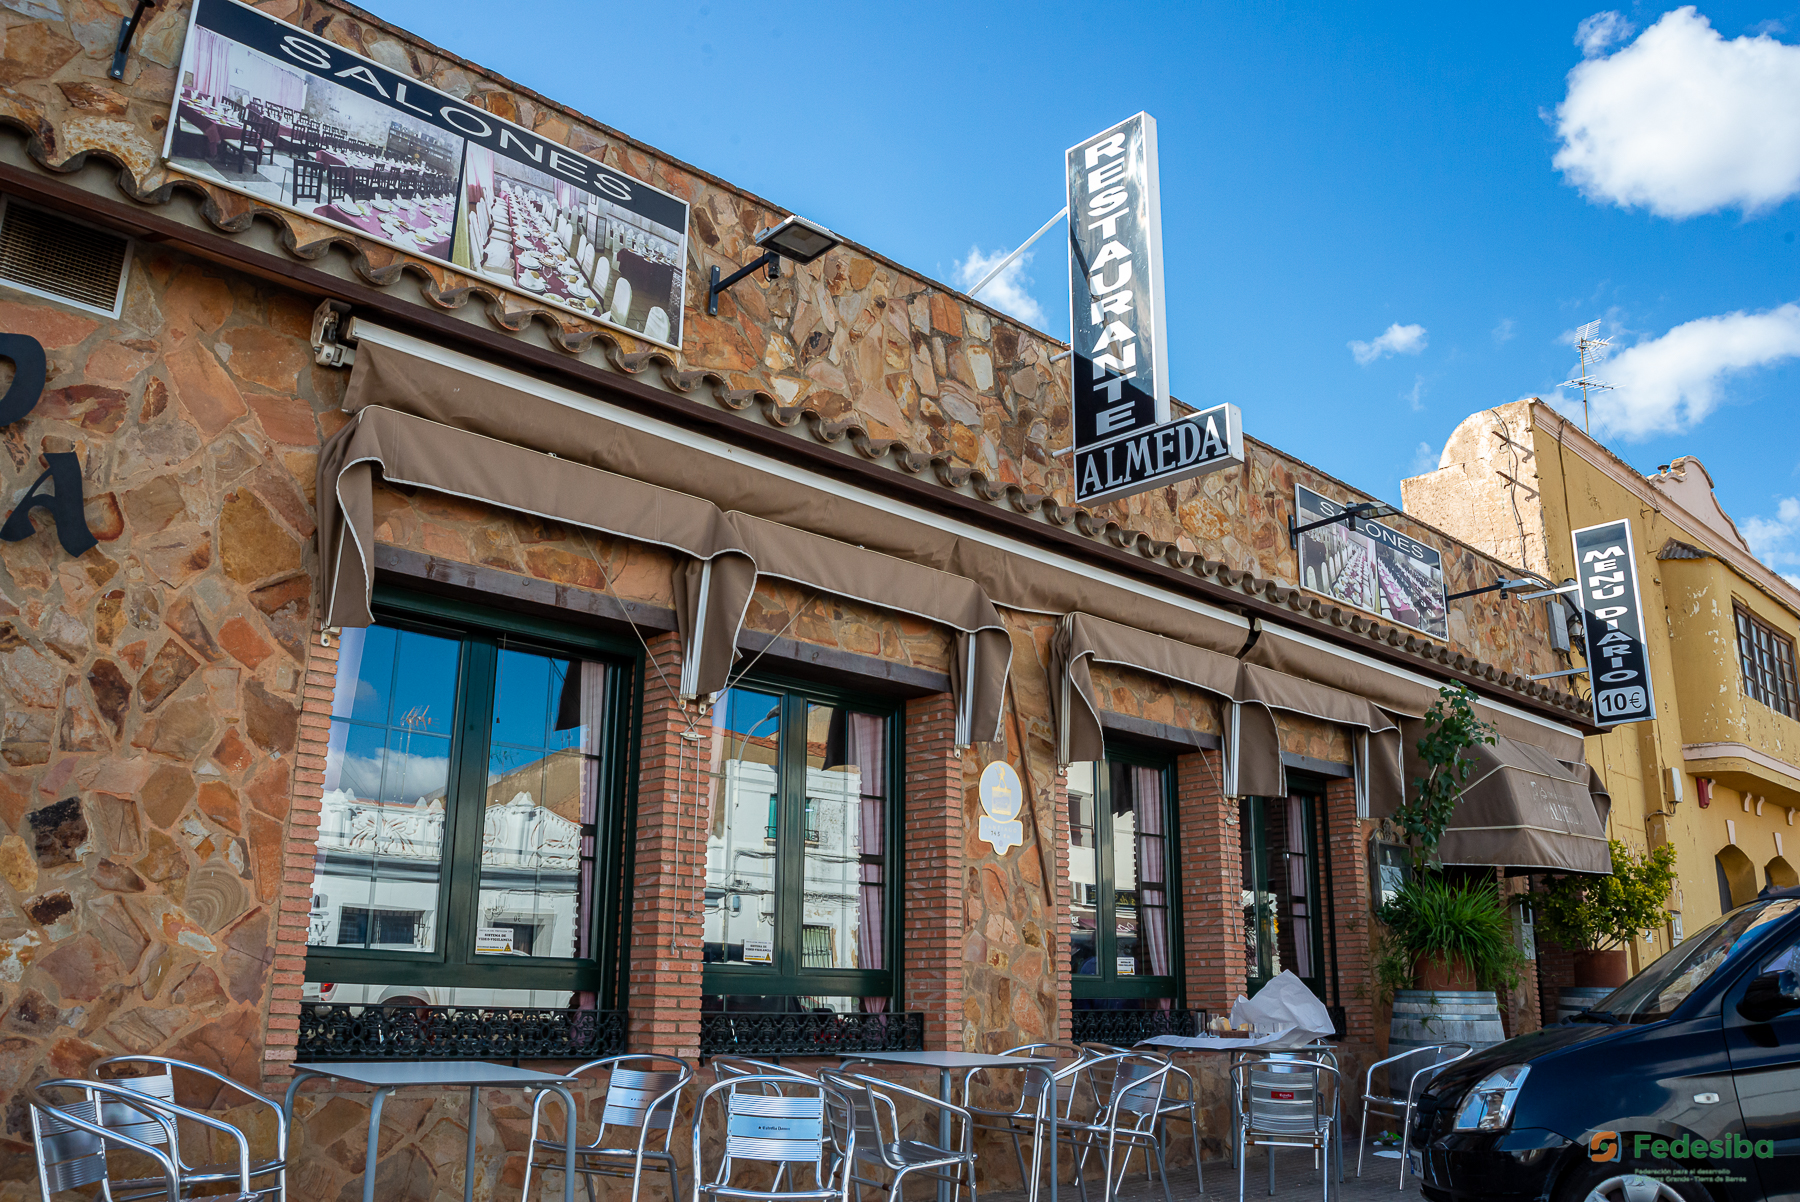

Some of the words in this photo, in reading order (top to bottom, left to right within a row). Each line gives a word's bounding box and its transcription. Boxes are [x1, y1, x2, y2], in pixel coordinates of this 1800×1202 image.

[280, 35, 633, 201] SALONES
[1084, 132, 1137, 437] RESTAURANTE
[1079, 415, 1227, 497] ALMEDA
[1320, 501, 1424, 559] SONES
[1583, 546, 1625, 600] MENÚ
[1597, 606, 1638, 682] DIARIO
[1602, 691, 1642, 712] 10€
